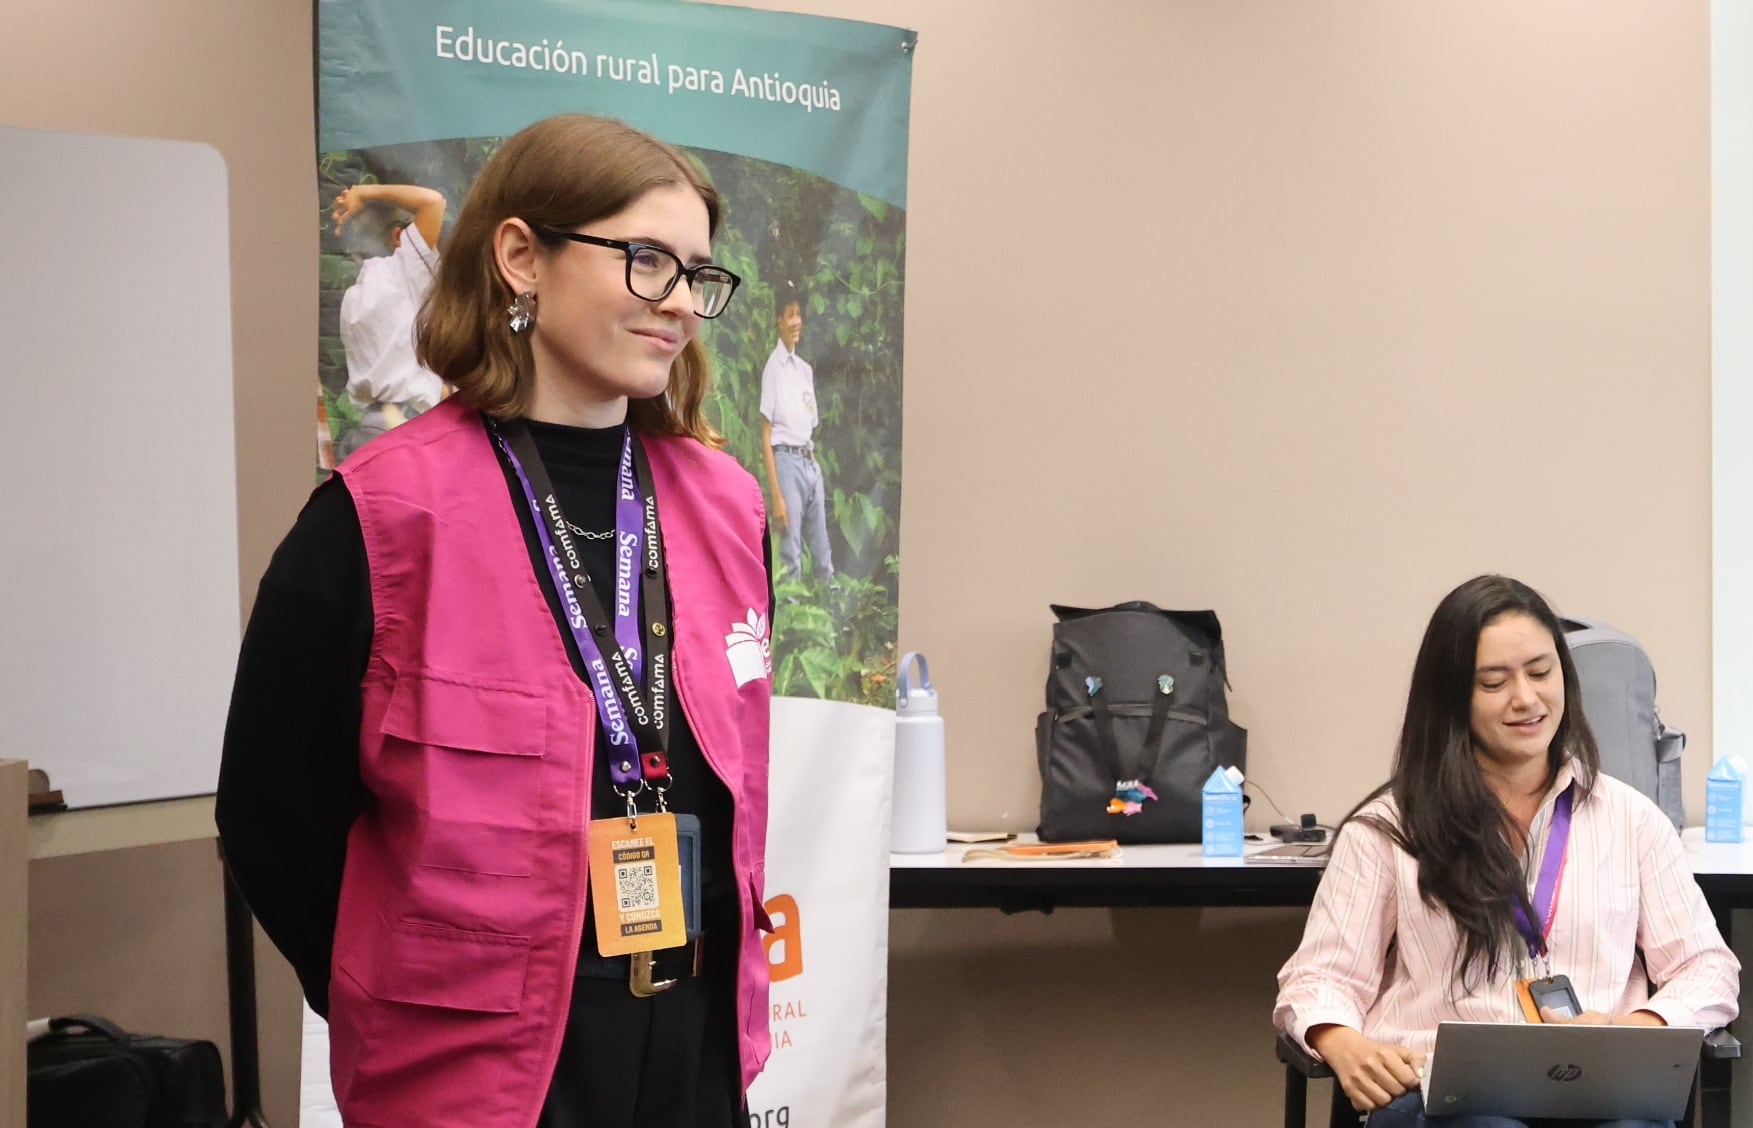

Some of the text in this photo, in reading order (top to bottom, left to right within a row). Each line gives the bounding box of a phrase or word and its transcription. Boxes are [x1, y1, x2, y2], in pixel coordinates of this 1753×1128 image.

[436, 25, 841, 112] Educación rural para Antioquia
[545, 494, 580, 569] comfama
[644, 496, 659, 569] comfama
[619, 531, 638, 618] Semana
[592, 659, 630, 746] Semana
[612, 651, 649, 726] comfama
[651, 653, 665, 730] comfama
